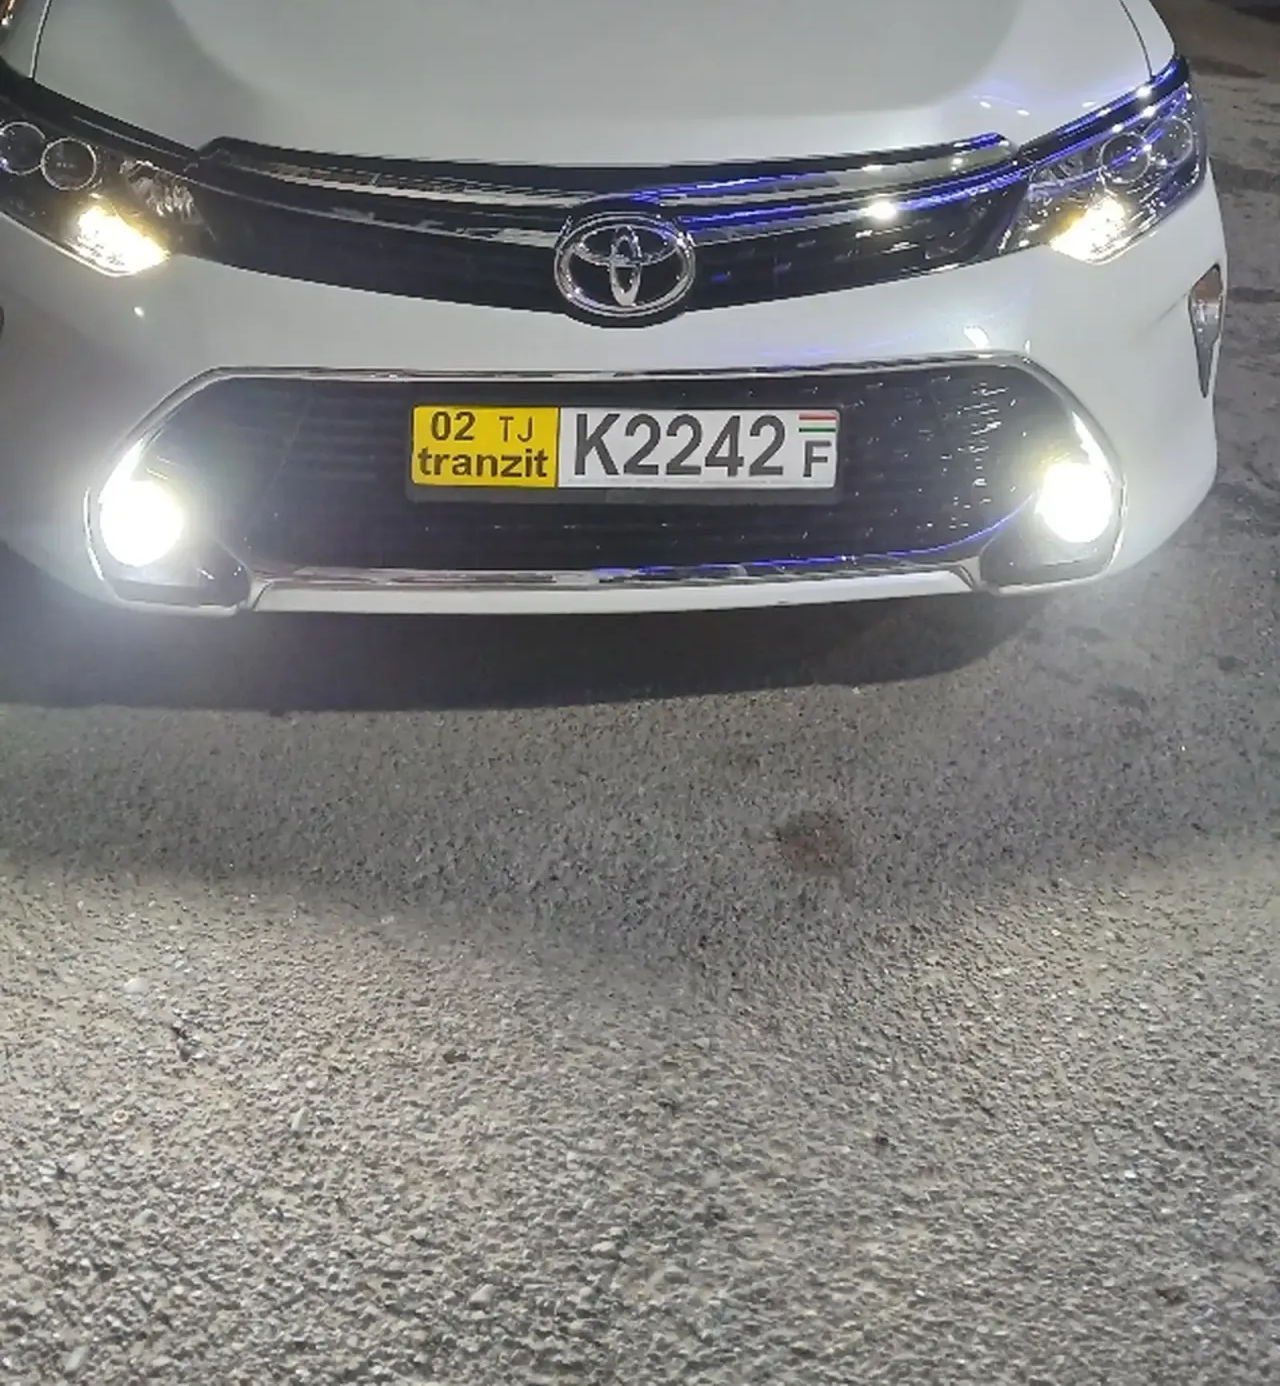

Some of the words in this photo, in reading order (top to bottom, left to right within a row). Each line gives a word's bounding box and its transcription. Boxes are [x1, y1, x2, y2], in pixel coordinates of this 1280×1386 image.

[430, 411, 476, 442] 02
[499, 415, 534, 443] TJ
[417, 446, 549, 479] tranzit
[573, 413, 786, 478] K2242
[803, 440, 832, 478] F
